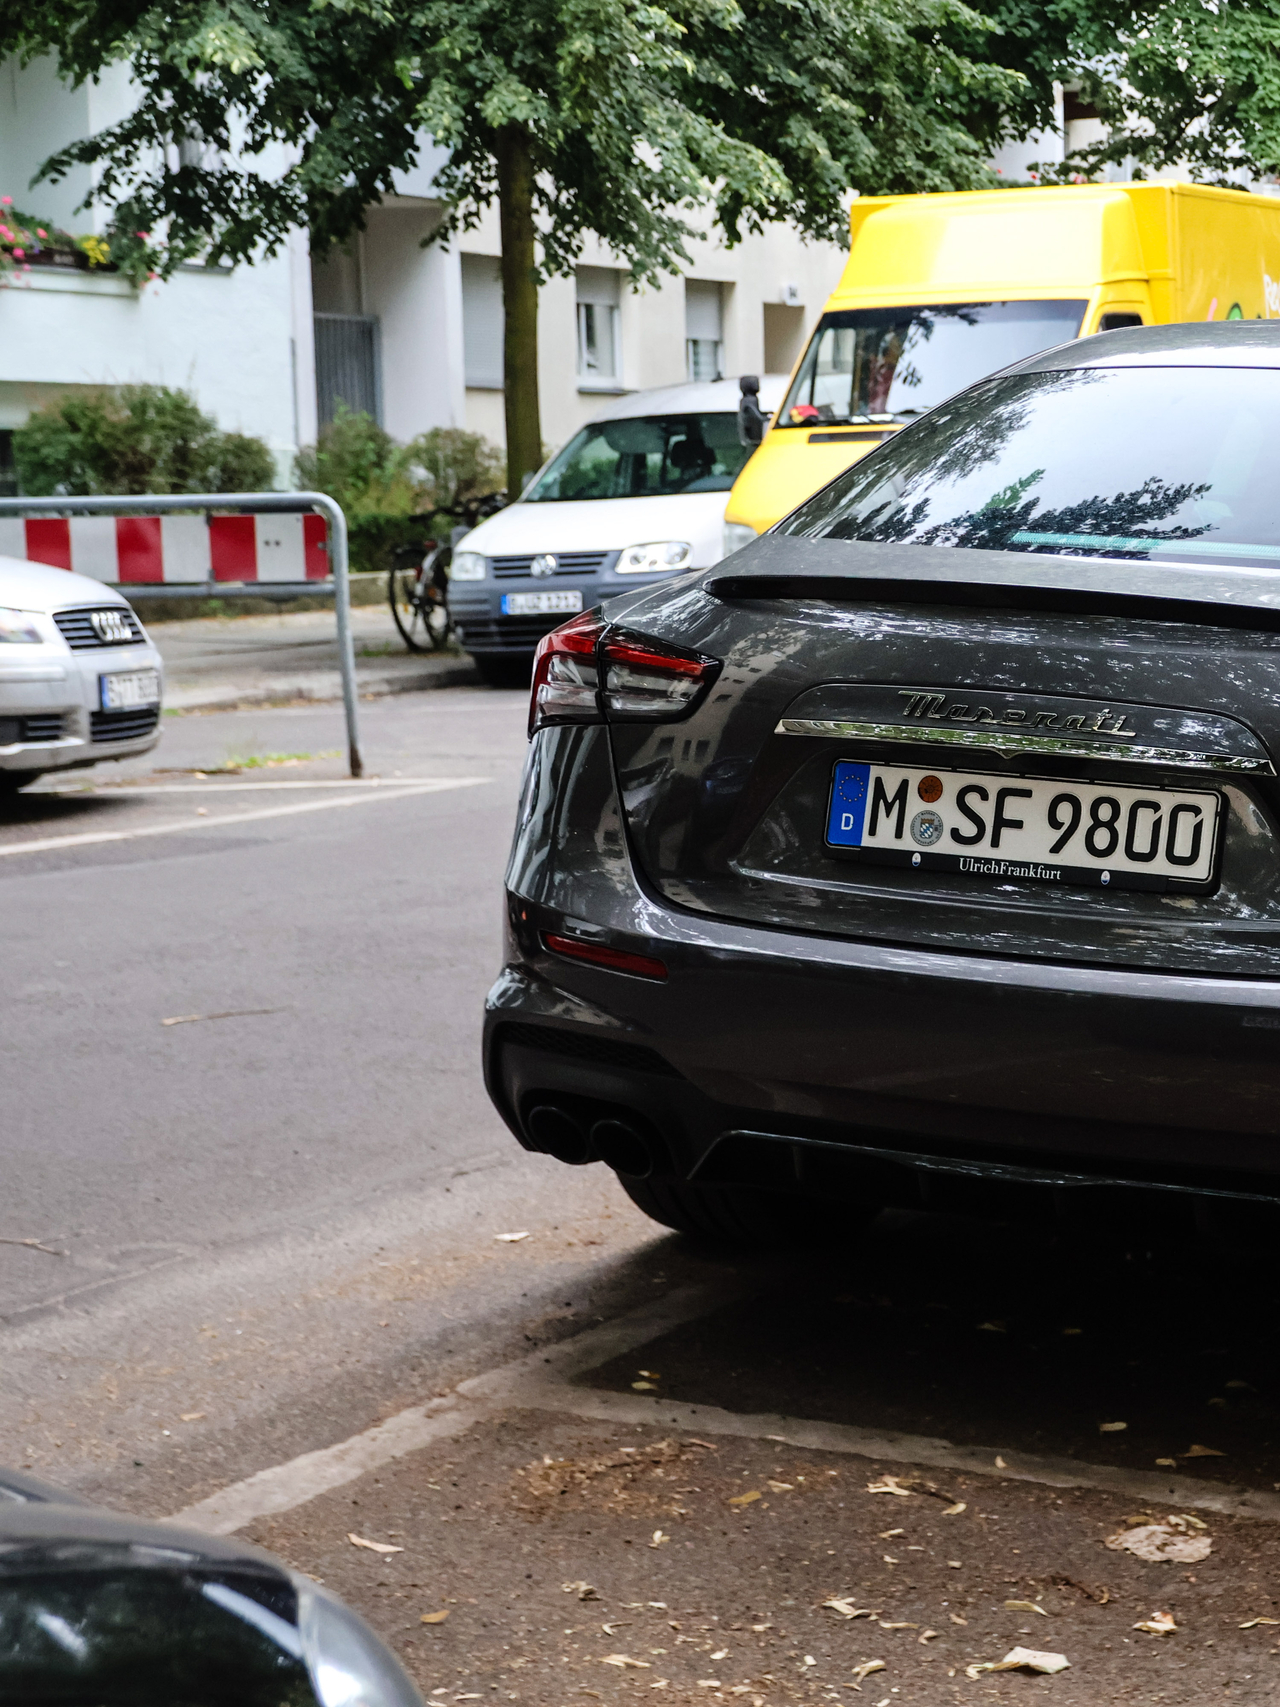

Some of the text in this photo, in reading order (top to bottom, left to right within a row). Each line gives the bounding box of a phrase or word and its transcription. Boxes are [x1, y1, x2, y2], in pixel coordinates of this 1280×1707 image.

[898, 690, 1137, 737] Maserati
[841, 813, 854, 830] D
[868, 776, 909, 839] M
[950, 784, 1033, 848] SF
[1047, 793, 1203, 866] 9800
[959, 857, 1062, 880] UlrichFrankfurt
